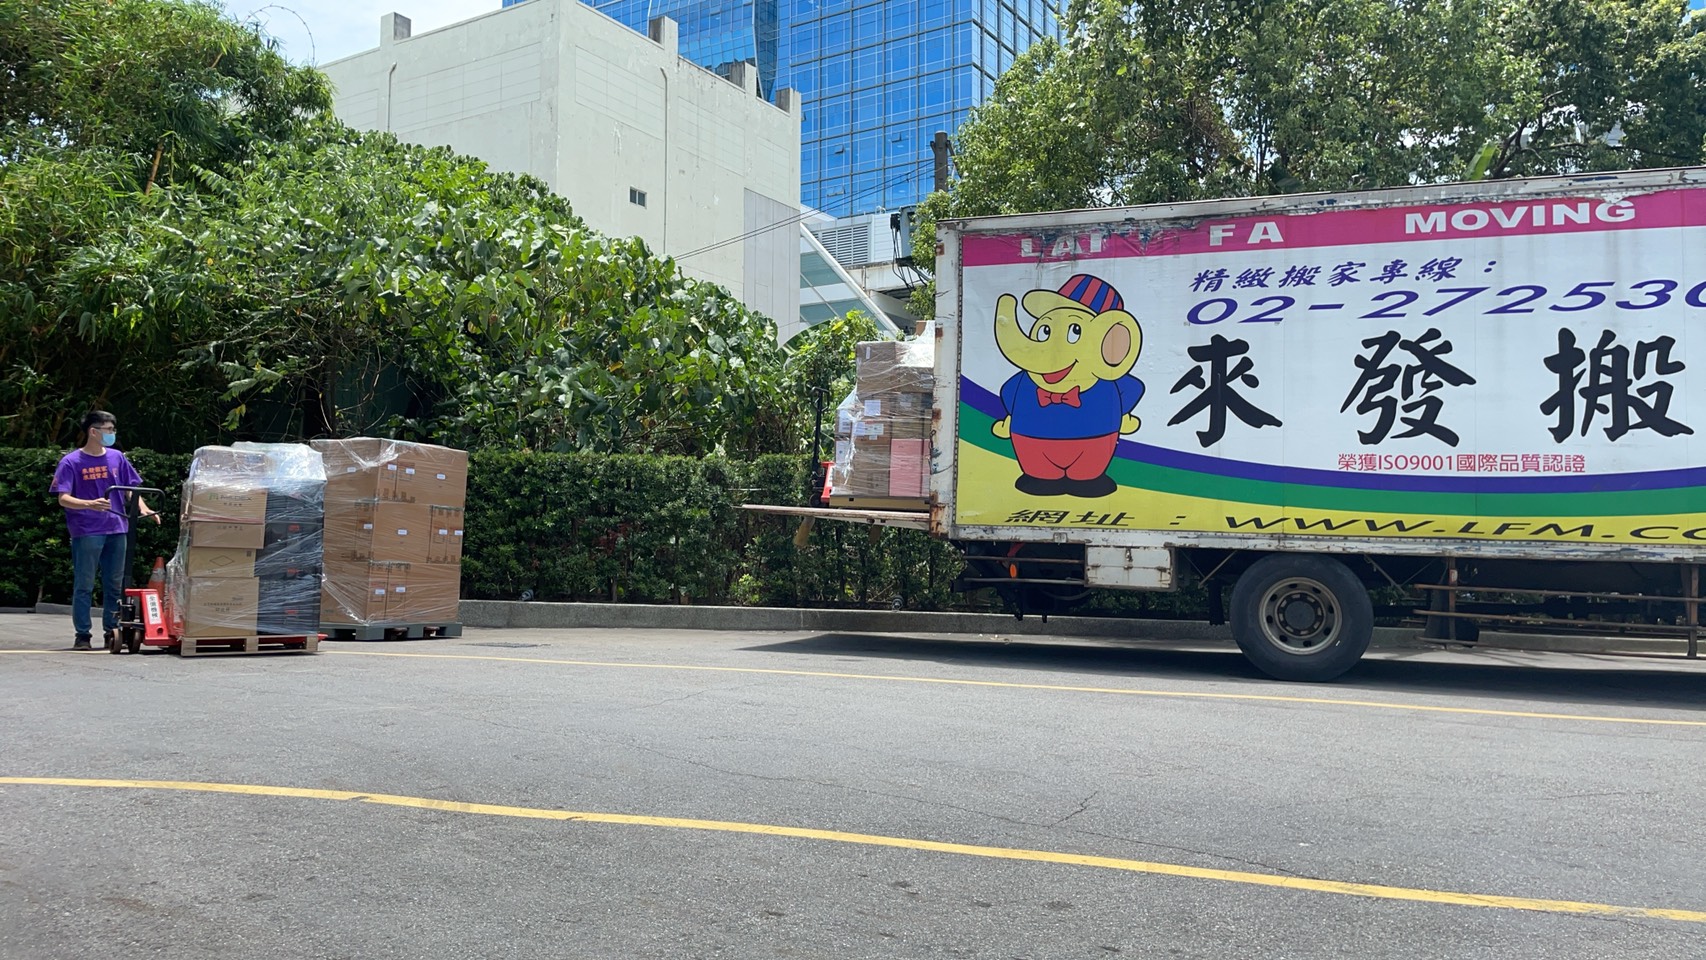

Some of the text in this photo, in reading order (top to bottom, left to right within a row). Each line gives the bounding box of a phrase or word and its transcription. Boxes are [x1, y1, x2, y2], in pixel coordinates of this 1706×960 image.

[1405, 200, 1636, 234] MOVING
[1166, 328, 1694, 448] 來發搬
[1338, 453, 1586, 473] 榮獲ISO9001國際品質認證
